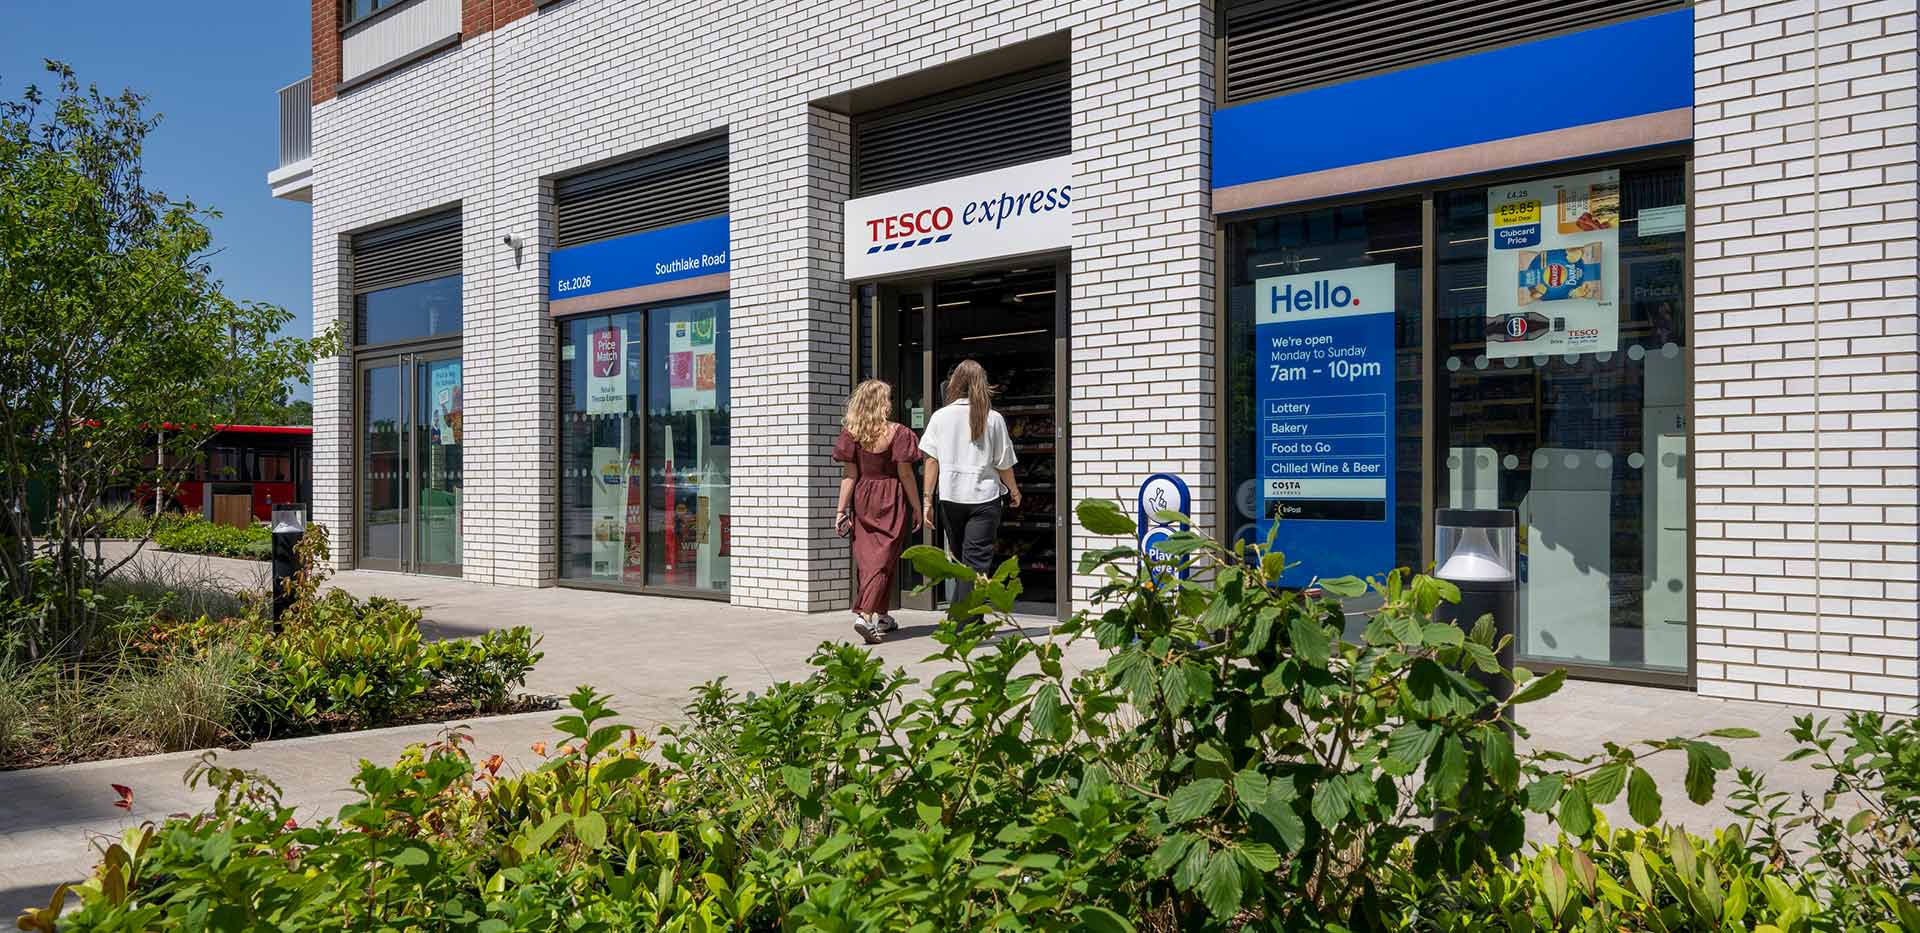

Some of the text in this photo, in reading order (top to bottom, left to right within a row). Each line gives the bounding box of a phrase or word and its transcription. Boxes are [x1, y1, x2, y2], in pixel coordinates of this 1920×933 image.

[866, 184, 1072, 242] TESCO express
[1500, 202, 1534, 216] £3.85
[1500, 227, 1535, 238] Clubcard
[1507, 237, 1527, 245] Price
[655, 251, 726, 276] Southlake Road
[558, 275, 592, 292] Est.2026
[1271, 279, 1360, 314] Hello.
[1568, 328, 1598, 337] TESCO
[598, 340, 616, 350] Price
[1272, 335, 1333, 348] We're open
[597, 351, 618, 361] Match
[1271, 345, 1367, 362] Monday to Sunday
[1270, 364, 1307, 382] 7am
[1328, 360, 1381, 382] 10pm
[1271, 402, 1311, 415] Lottery
[1271, 422, 1308, 435] Bakery
[1271, 442, 1331, 454] Food to Go
[1271, 462, 1381, 474] Chilled Wine & Beer
